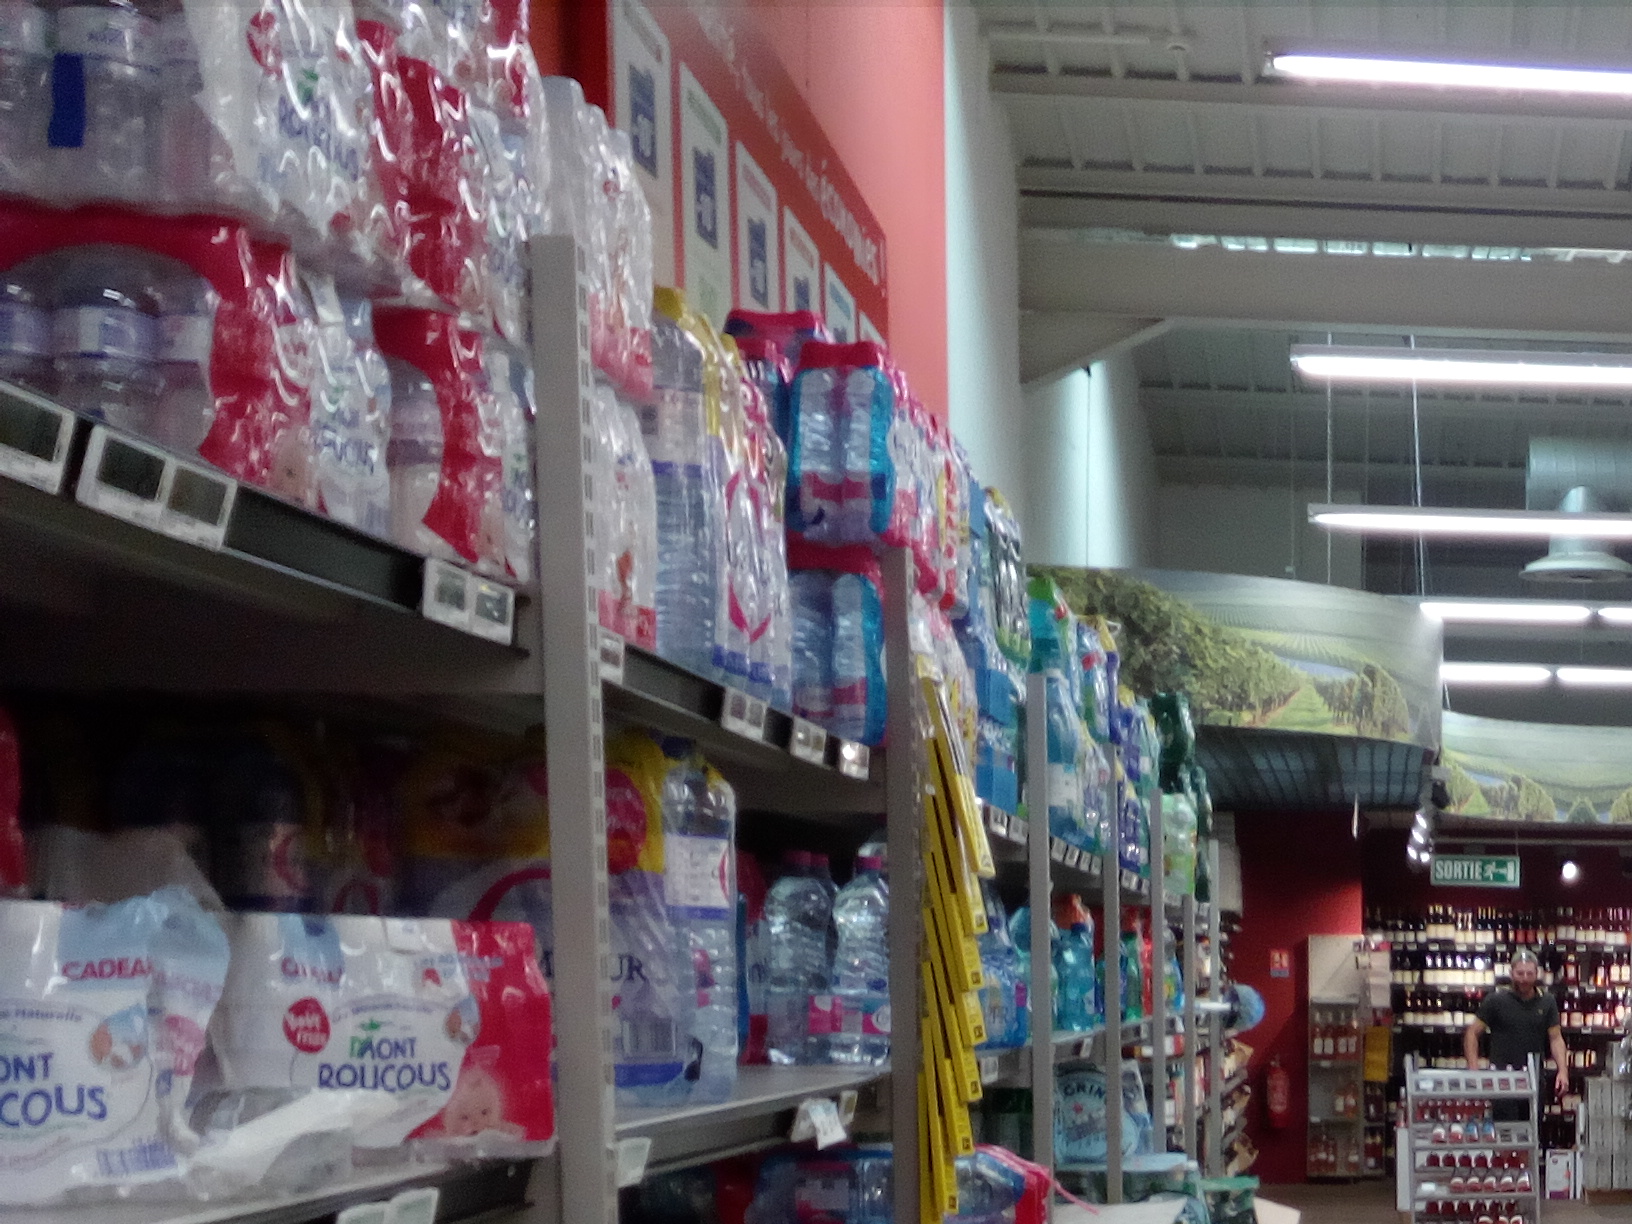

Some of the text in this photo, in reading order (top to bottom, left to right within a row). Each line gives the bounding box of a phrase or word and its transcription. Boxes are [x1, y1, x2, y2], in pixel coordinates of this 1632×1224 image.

[1435, 860, 1482, 880] SORTIE
[350, 1036, 416, 1060] MONT
[318, 1062, 451, 1092] ROUCOUS
